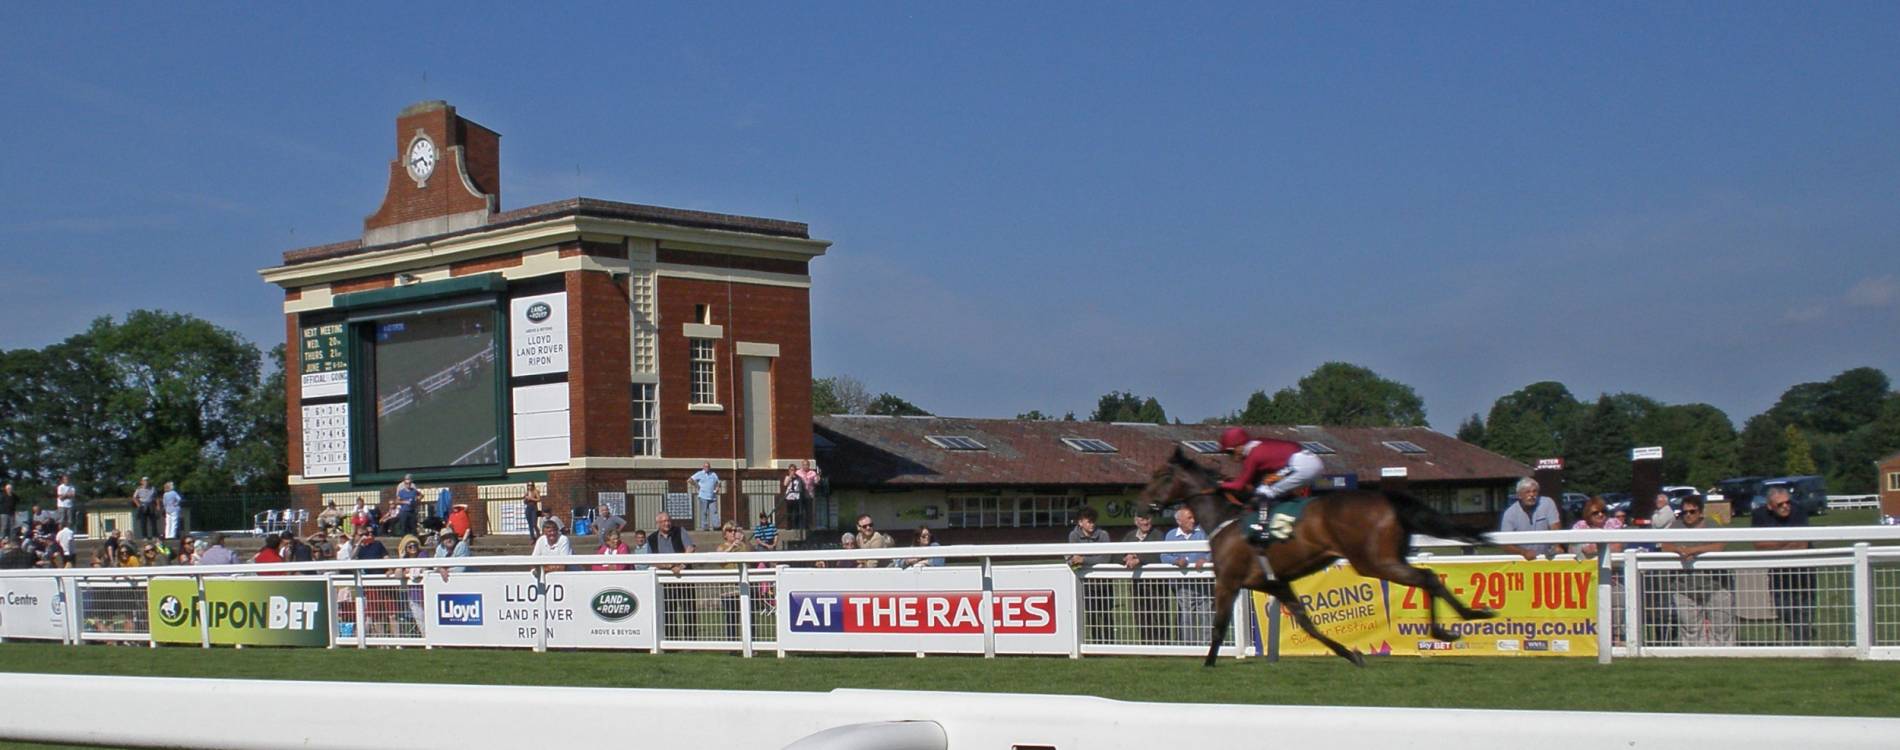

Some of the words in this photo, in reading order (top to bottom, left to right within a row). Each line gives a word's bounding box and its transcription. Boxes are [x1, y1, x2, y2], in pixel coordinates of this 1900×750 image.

[303, 327, 317, 338] NEXT
[320, 324, 343, 336] MEETING
[528, 335, 551, 345] LLOYD
[516, 346, 536, 357] LAND
[538, 344, 564, 355] ROVER
[528, 356, 551, 367] RIPON
[303, 374, 327, 385] OFFICIAL
[1469, 572, 1524, 609] 29TH
[1531, 571, 1592, 609] JULY
[7, 591, 38, 606] Centre
[600, 594, 623, 604] LAND
[440, 600, 480, 622] Lloyd
[499, 609, 528, 620] LAND
[533, 609, 573, 620] RVER
[601, 604, 630, 614] ROVER
[795, 597, 838, 627] AT
[848, 597, 919, 627] THE
[926, 596, 1050, 628] RACES
[1311, 604, 1376, 626] ORKSHIRE
[518, 627, 554, 638] RIPN
[1398, 618, 1598, 639] wwgoracing.co.uk
